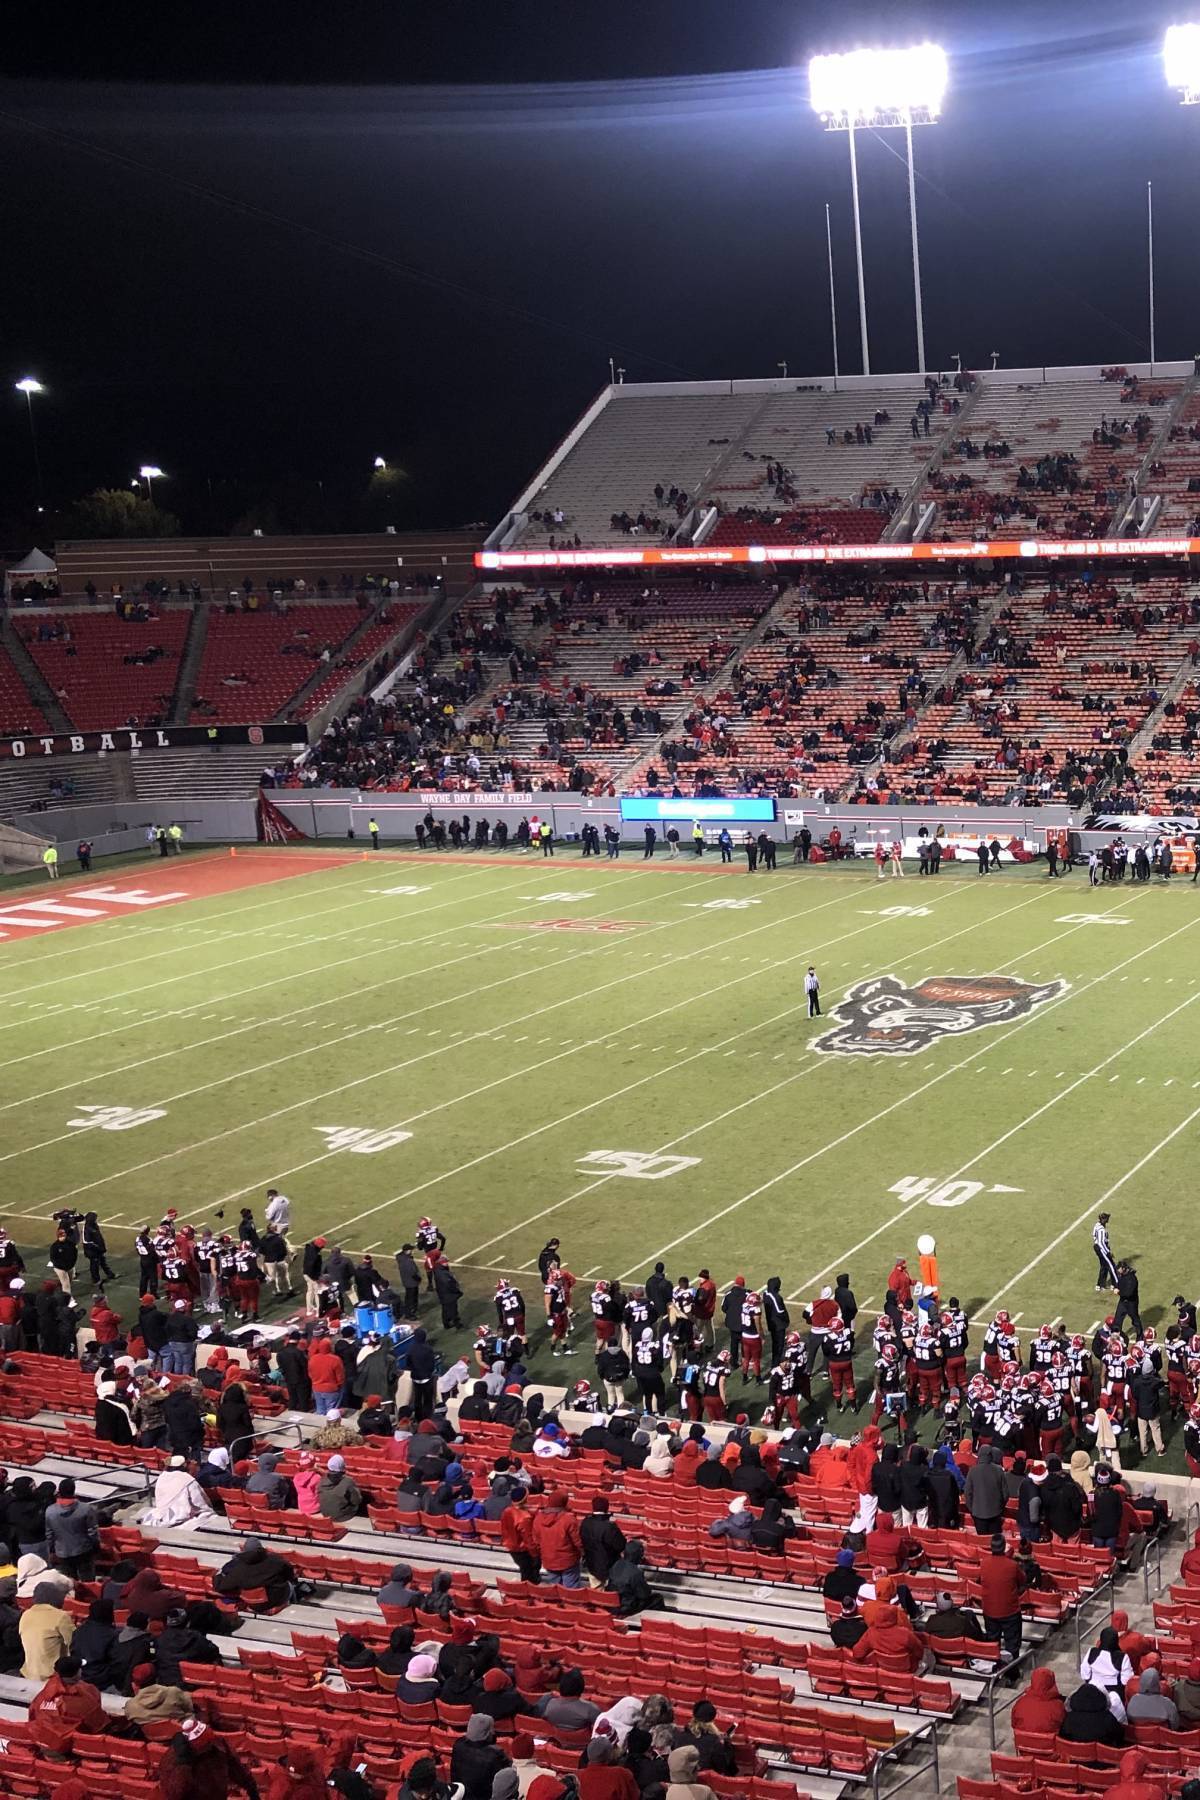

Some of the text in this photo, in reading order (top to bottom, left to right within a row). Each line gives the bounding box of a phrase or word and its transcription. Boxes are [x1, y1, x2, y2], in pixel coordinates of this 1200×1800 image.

[1039, 541, 1191, 554] THINK AND DO THE EXTRAORDINARY
[421, 794, 532, 804] WAYNE DAY FAMILY FIELD
[66, 1107, 169, 1130] 30
[323, 1127, 414, 1153] 40
[887, 1176, 986, 1207] 40
[503, 1296, 519, 1310] 33
[633, 1311, 648, 1322] 76
[834, 1342, 851, 1354] 73
[1036, 1352, 1051, 1363] 39
[1108, 1366, 1122, 1378] 36
[1054, 1378, 1069, 1390] 38
[1047, 1406, 1062, 1421] 57
